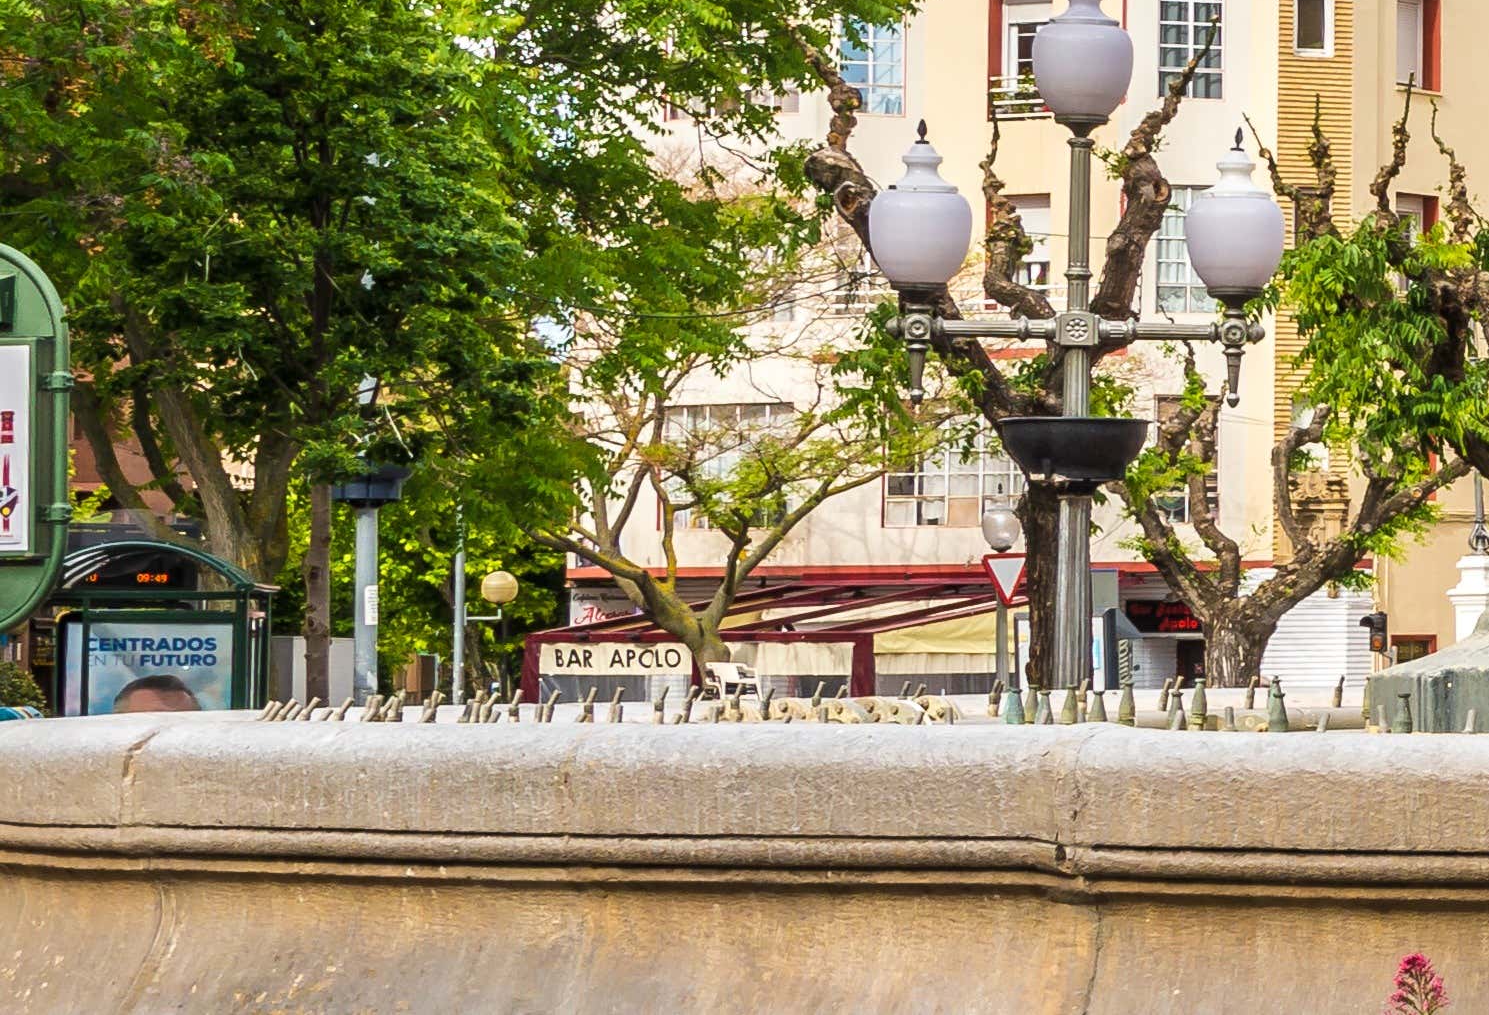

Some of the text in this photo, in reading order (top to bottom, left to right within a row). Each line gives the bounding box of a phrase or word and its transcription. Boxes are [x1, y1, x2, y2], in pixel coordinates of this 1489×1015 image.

[88, 637, 217, 651] CENTRADOS
[112, 655, 136, 666] TU
[139, 654, 217, 666] FUTURO
[555, 648, 682, 668] BAR APOLO
